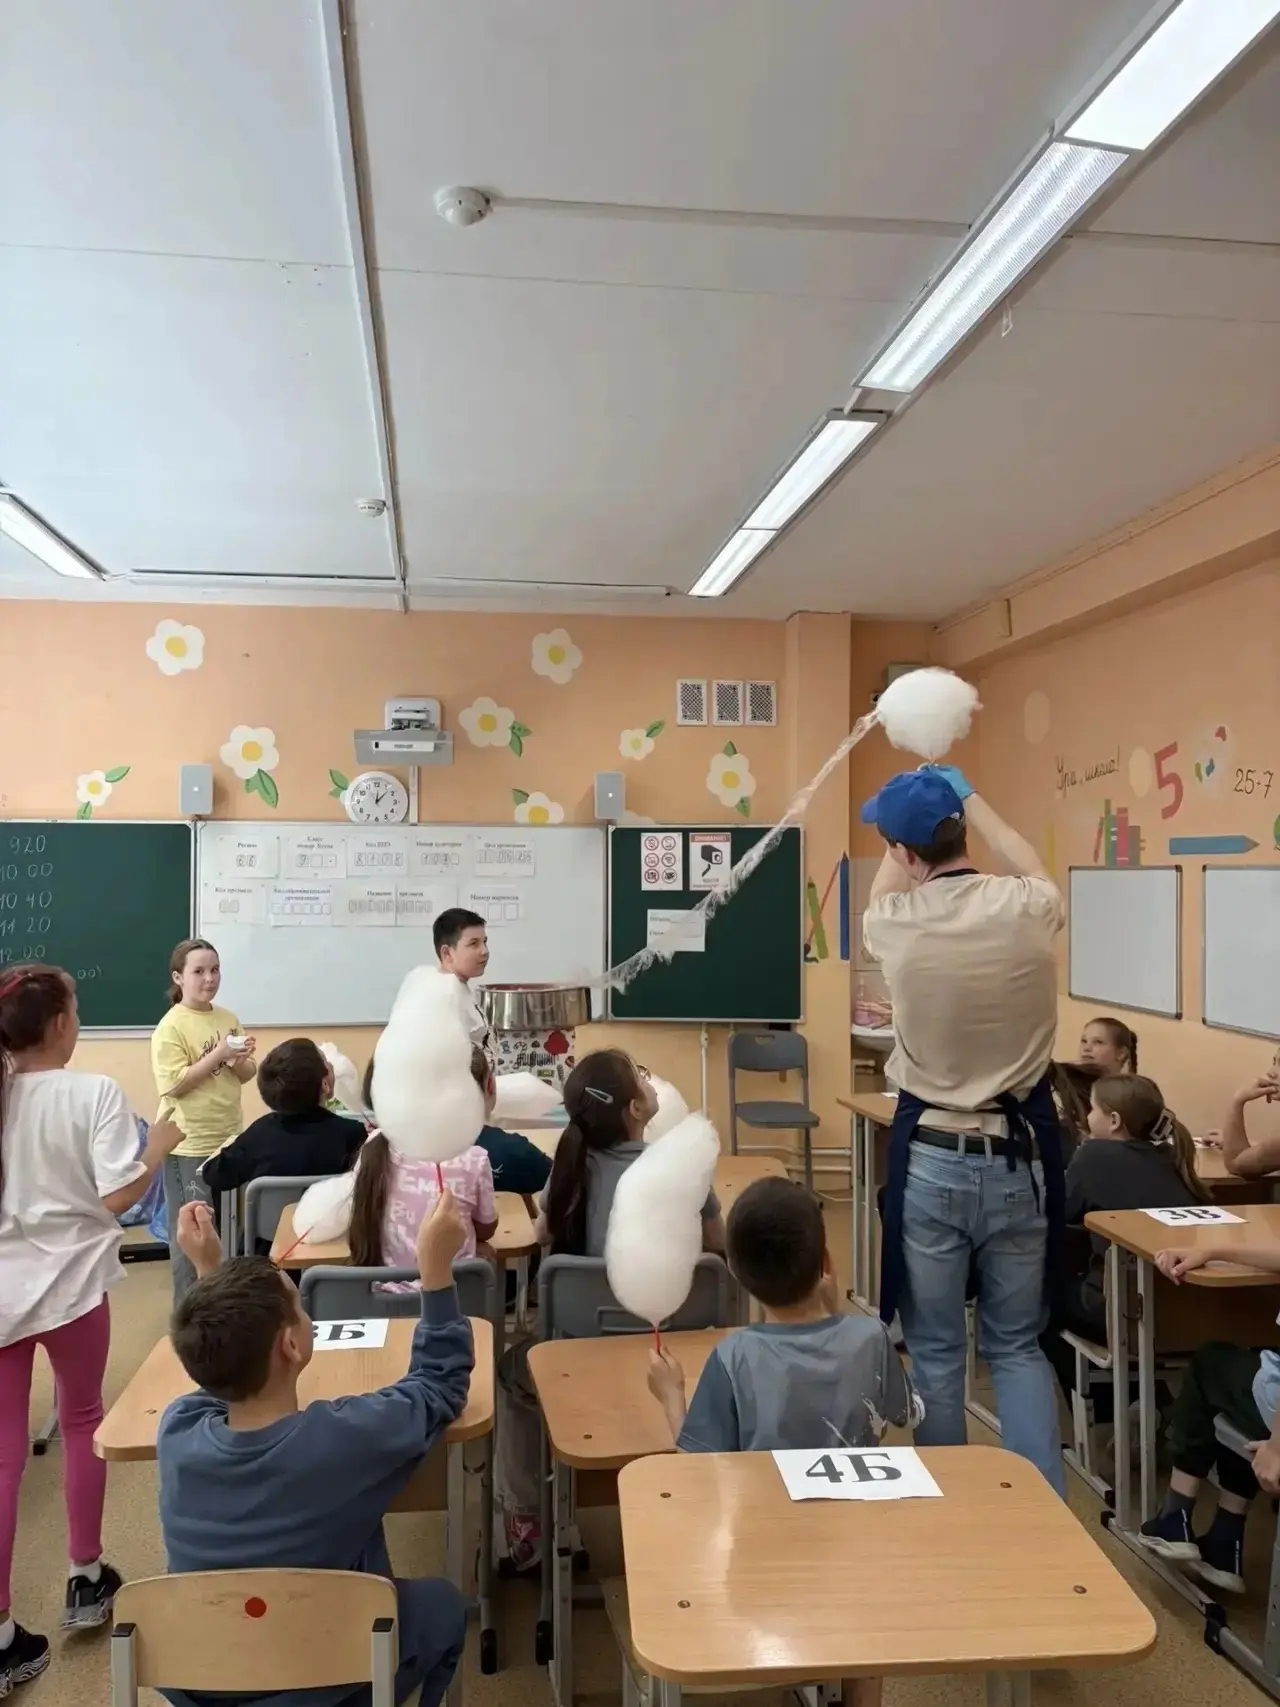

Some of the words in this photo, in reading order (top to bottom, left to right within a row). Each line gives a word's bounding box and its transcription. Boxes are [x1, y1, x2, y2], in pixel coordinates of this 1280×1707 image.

[1154, 741, 1184, 820] 5
[28, 862, 54, 878] 00
[25, 890, 52, 909] 40
[26, 916, 51, 933] 20
[804, 1452, 902, 1483] 4Б
